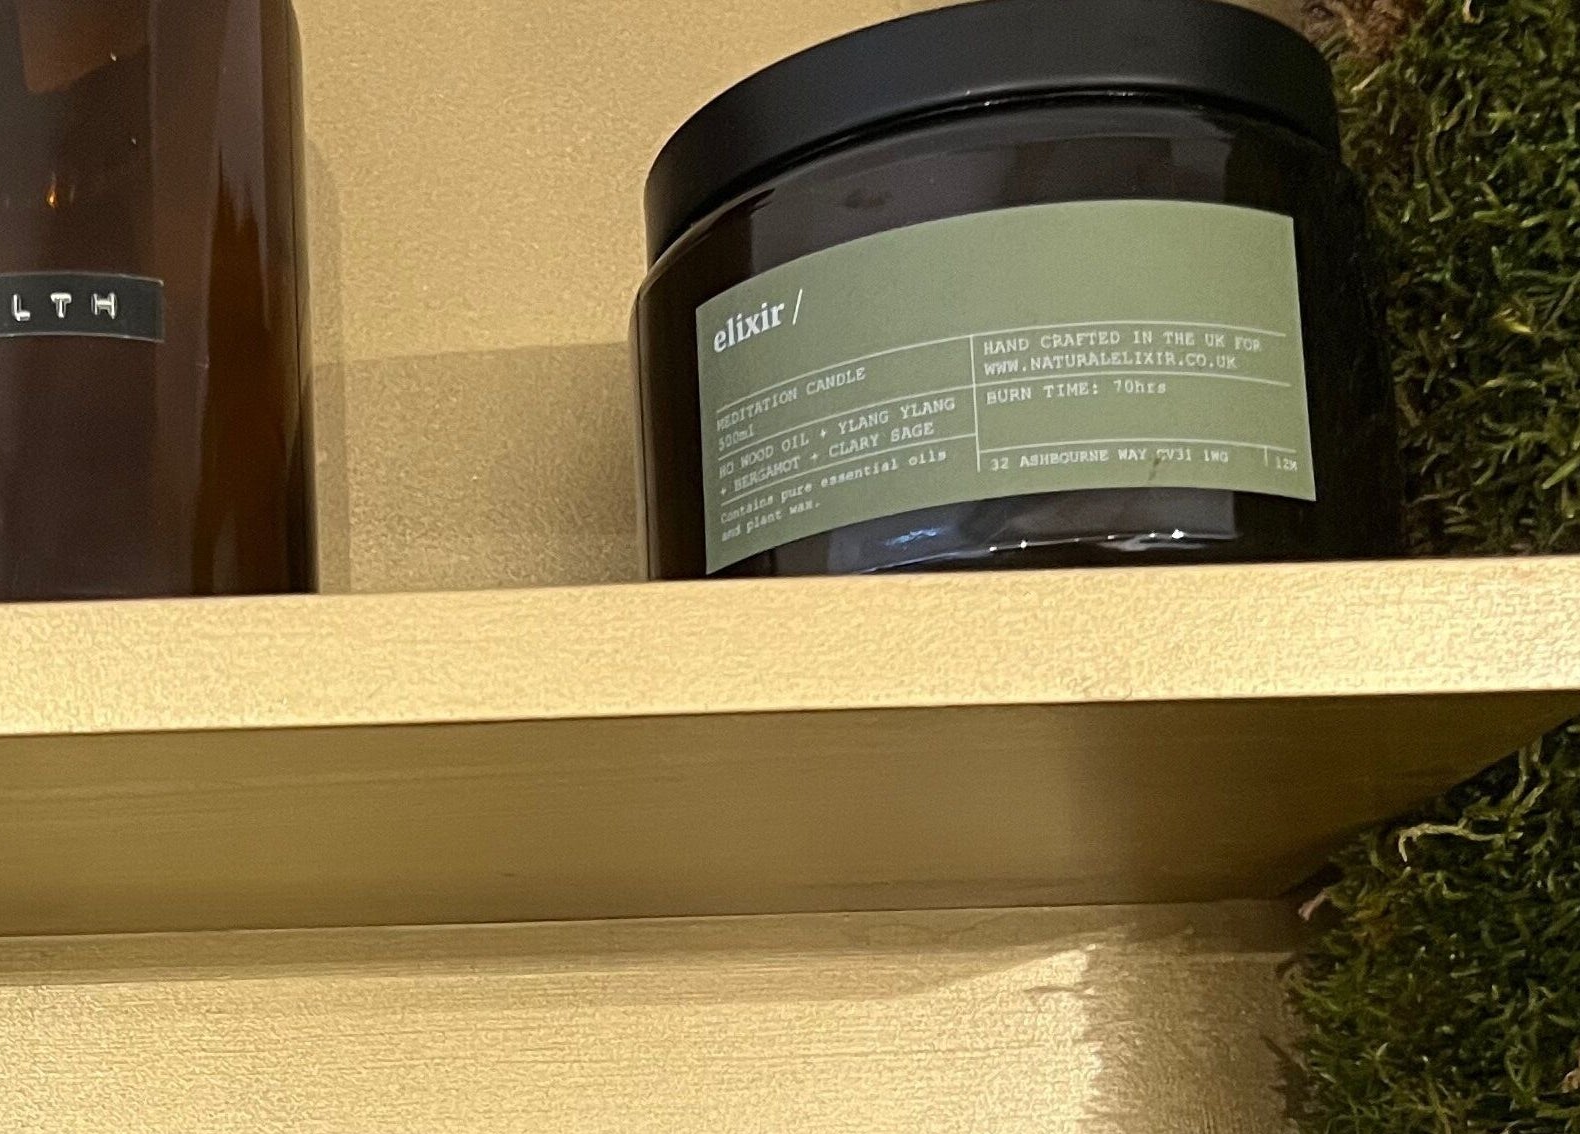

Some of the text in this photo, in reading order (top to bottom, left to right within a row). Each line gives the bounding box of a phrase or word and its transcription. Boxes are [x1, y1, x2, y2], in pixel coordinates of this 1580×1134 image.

[713, 302, 785, 353] elixir
[983, 330, 1261, 356] HAND CRAFTED IN THE UK FOR
[983, 350, 1238, 376] WWW.NATURALELIXIR.CO.UK
[716, 366, 866, 432] MEDITATION CANDLE
[986, 379, 1167, 405] BURN TIME: 70hrs
[741, 445, 774, 468] WOOD
[782, 432, 810, 453] OIL
[838, 410, 889, 435] YLANG
[900, 397, 956, 419] YLANG
[734, 456, 801, 493] BERGAMOT
[828, 433, 879, 458] CLARY
[890, 422, 934, 443] SAGE
[820, 458, 898, 488] essential
[908, 449, 947, 466] oils
[990, 456, 1009, 471] 32
[1020, 449, 1109, 468] ASHBOURNE
[1118, 448, 1149, 461] WAY
